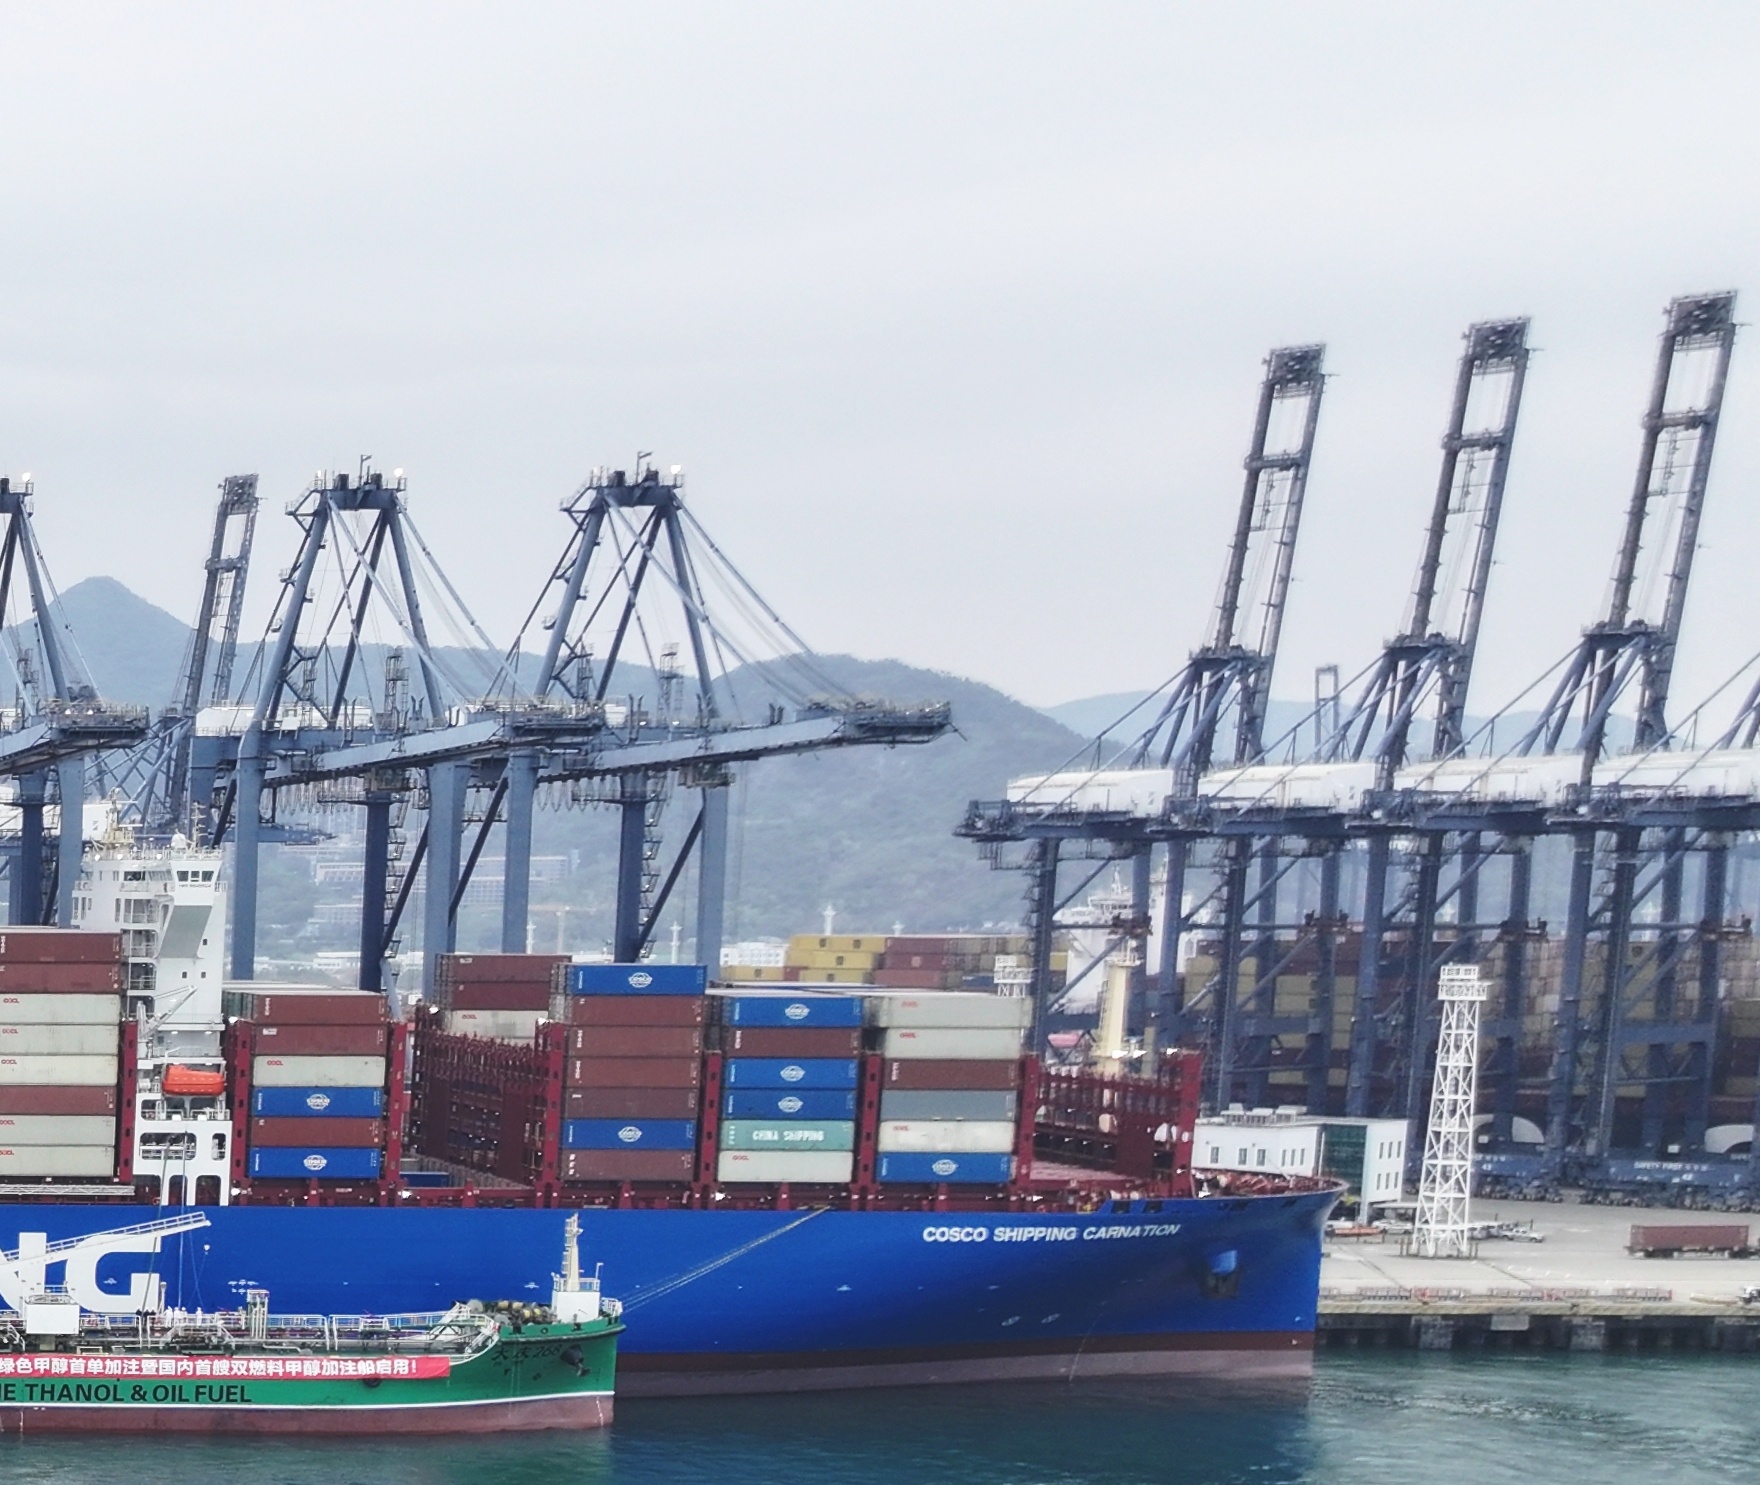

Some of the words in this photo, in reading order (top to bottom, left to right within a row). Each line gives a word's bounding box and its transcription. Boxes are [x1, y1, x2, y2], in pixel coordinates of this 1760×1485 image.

[752, 1130, 779, 1141] CHINA
[783, 1130, 824, 1141] SHIPPING
[922, 1227, 989, 1243] COSCO
[993, 1227, 1078, 1242] SHIPPING
[1082, 1224, 1180, 1240] CARNATION
[130, 1385, 147, 1402] &
[153, 1385, 191, 1403] OIL
[194, 1385, 252, 1404] FUEL
